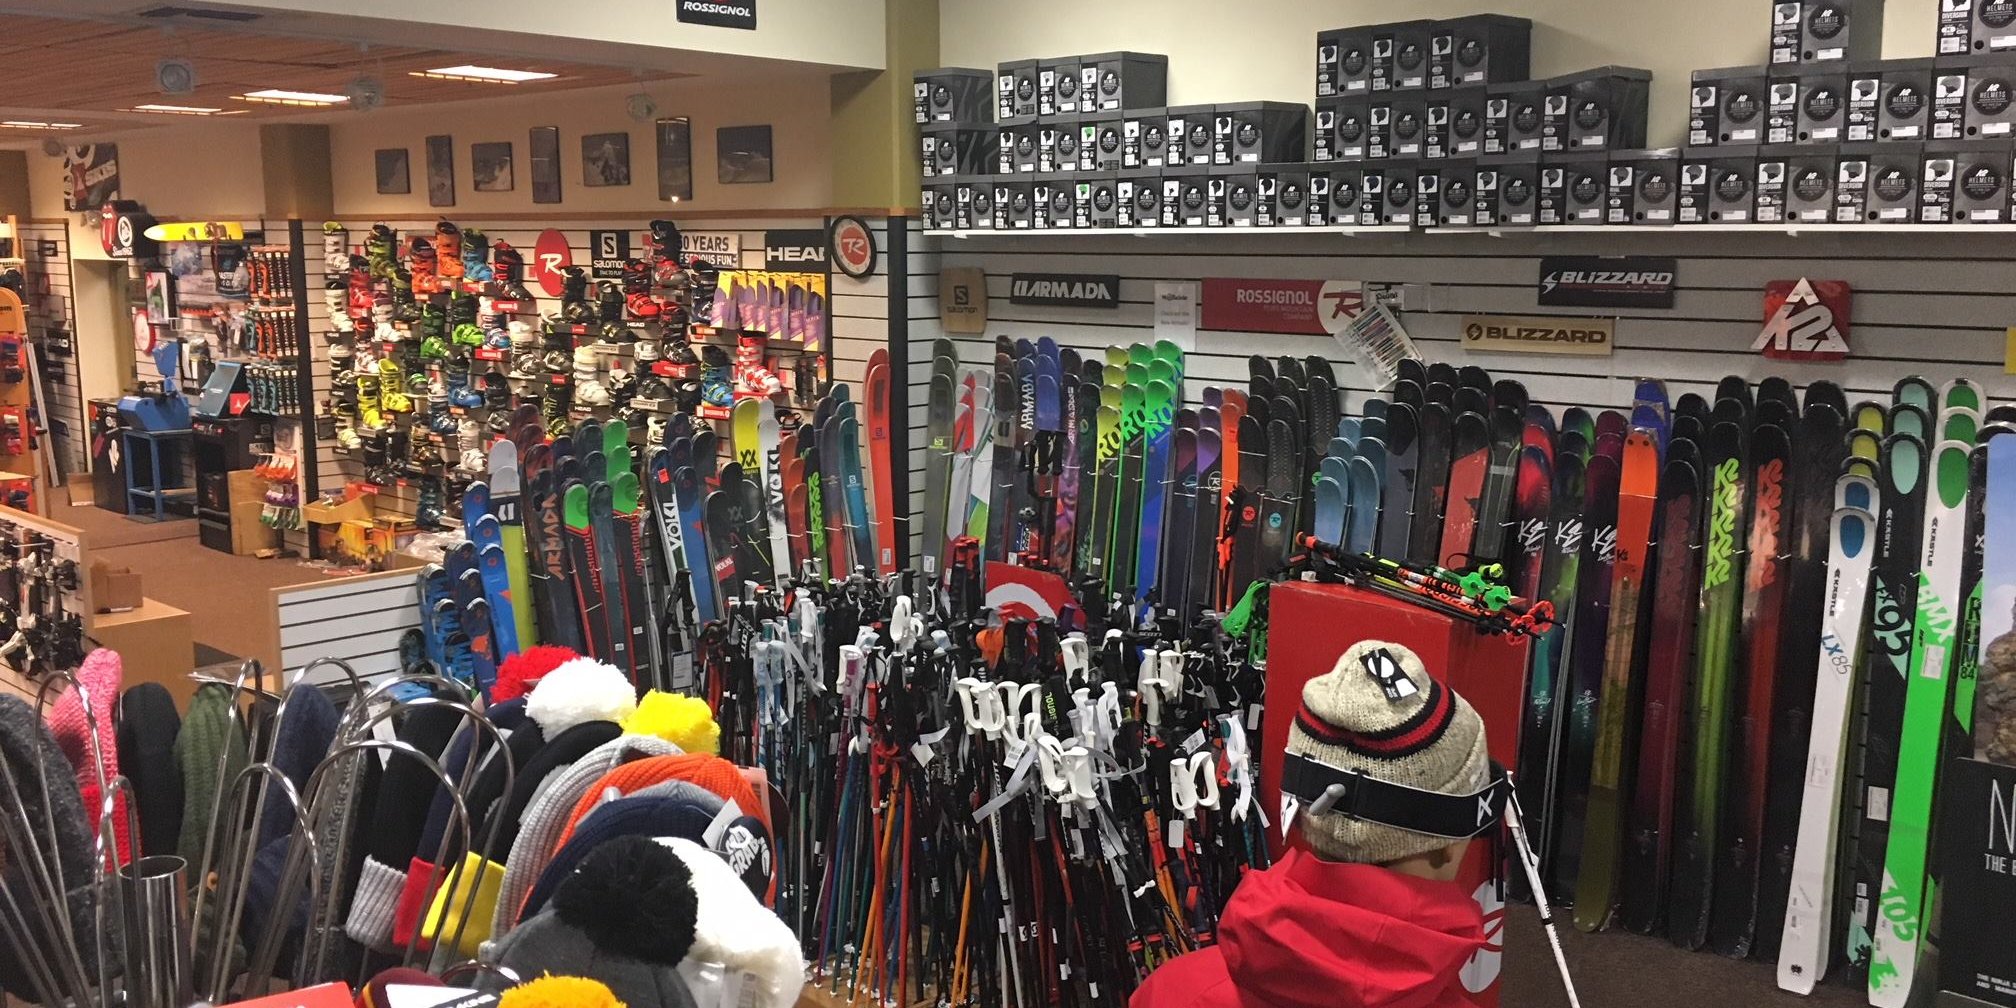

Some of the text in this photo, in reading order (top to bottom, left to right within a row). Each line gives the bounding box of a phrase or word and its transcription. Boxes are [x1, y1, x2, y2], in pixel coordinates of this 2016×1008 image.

[683, 1, 751, 17] ROSSIGNOL
[1986, 3, 2013, 13] HELMETS
[1815, 16, 1839, 24] HELMETS
[1892, 95, 1918, 104] HELMETS
[1979, 90, 2006, 99] HELMETS
[1880, 178, 1906, 187] HELMETS
[1968, 176, 1996, 185] HELMETS
[692, 235, 729, 252] YEARS
[1560, 271, 1673, 285] BLIZZARD
[1026, 281, 1112, 300] ARMADA
[1237, 288, 1314, 305] ROSSIGNOL
[1486, 326, 1606, 344] BLIZZARD
[1020, 374, 1034, 430] ARMADA
[1714, 458, 1739, 490] K2
[1712, 483, 1737, 515] K2
[1709, 508, 1735, 541] K2
[540, 493, 565, 581] ARMADA
[1707, 534, 1733, 566] K2
[1704, 559, 1731, 591] K2
[1874, 604, 1911, 656] 95
[1821, 634, 1852, 675] LX 85
[1960, 667, 1975, 680] 84
[728, 837, 760, 878] GRAB
[1984, 852, 2006, 874] THE
[1881, 886, 1917, 941] 105
